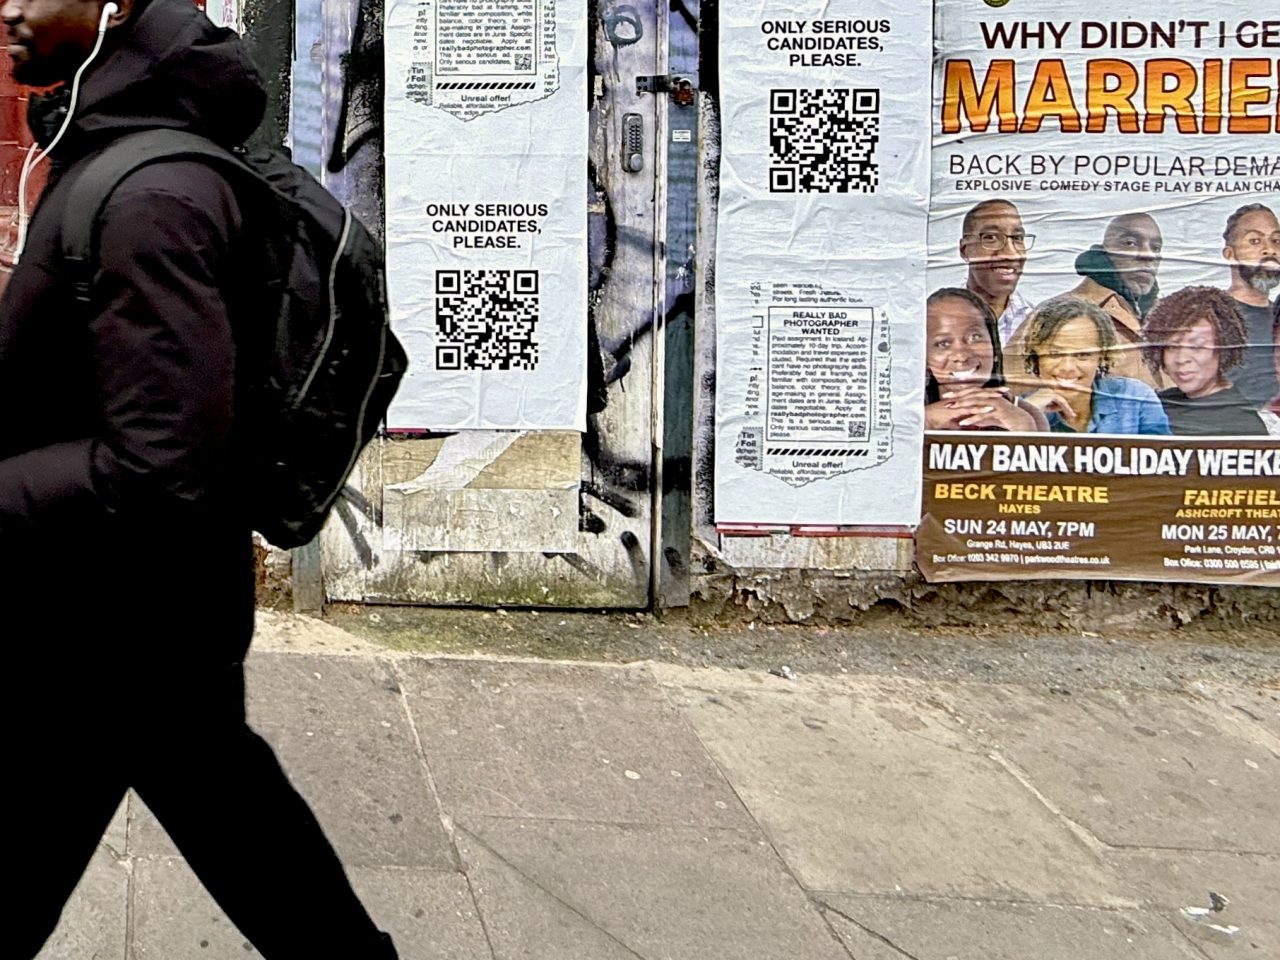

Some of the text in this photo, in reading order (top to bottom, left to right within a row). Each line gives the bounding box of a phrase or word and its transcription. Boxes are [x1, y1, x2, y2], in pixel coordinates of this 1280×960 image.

[762, 20, 890, 35] ONLY SERIOUS
[980, 21, 1072, 49] WHY
[1219, 21, 1226, 49] I
[767, 37, 884, 52] CANDIDATES,
[790, 53, 861, 67] PLEASE.
[941, 58, 1280, 134] MARRIE
[949, 154, 1022, 176] BACK
[1030, 154, 1066, 176] BY
[1074, 155, 1205, 176] POPULAR
[955, 179, 1032, 191] EXPLOSIVE
[1040, 179, 1101, 192] COMEDY
[1104, 180, 1150, 192] STAGE
[1154, 181, 1190, 193] PLAY
[1194, 181, 1213, 193] BY
[1215, 181, 1250, 192] ALAN
[426, 203, 548, 217] ONLY SERIOUS
[432, 219, 542, 235] CANDIDATES,
[453, 235, 521, 249] PLEASE.
[784, 320, 858, 328] PHOTOGRAPHER
[929, 443, 988, 471] MAY
[992, 445, 1069, 473] BANK
[1074, 446, 1194, 476] HOLIDAY
[934, 483, 1110, 503] BECK THEATRE
[1183, 489, 1280, 506] FAIRFIEL
[999, 504, 1041, 515] HAYES
[1175, 508, 1242, 519] ASHCROFT
[944, 519, 1095, 538] SUN 24 MAY, 7PM
[1161, 524, 1204, 540] MON
[1207, 525, 1228, 540] 25
[1231, 525, 1272, 543] MAY,
[966, 539, 993, 550] Grange
[1184, 545, 1202, 554] Park
[933, 554, 946, 563] Box
[1163, 557, 1180, 567] Box
